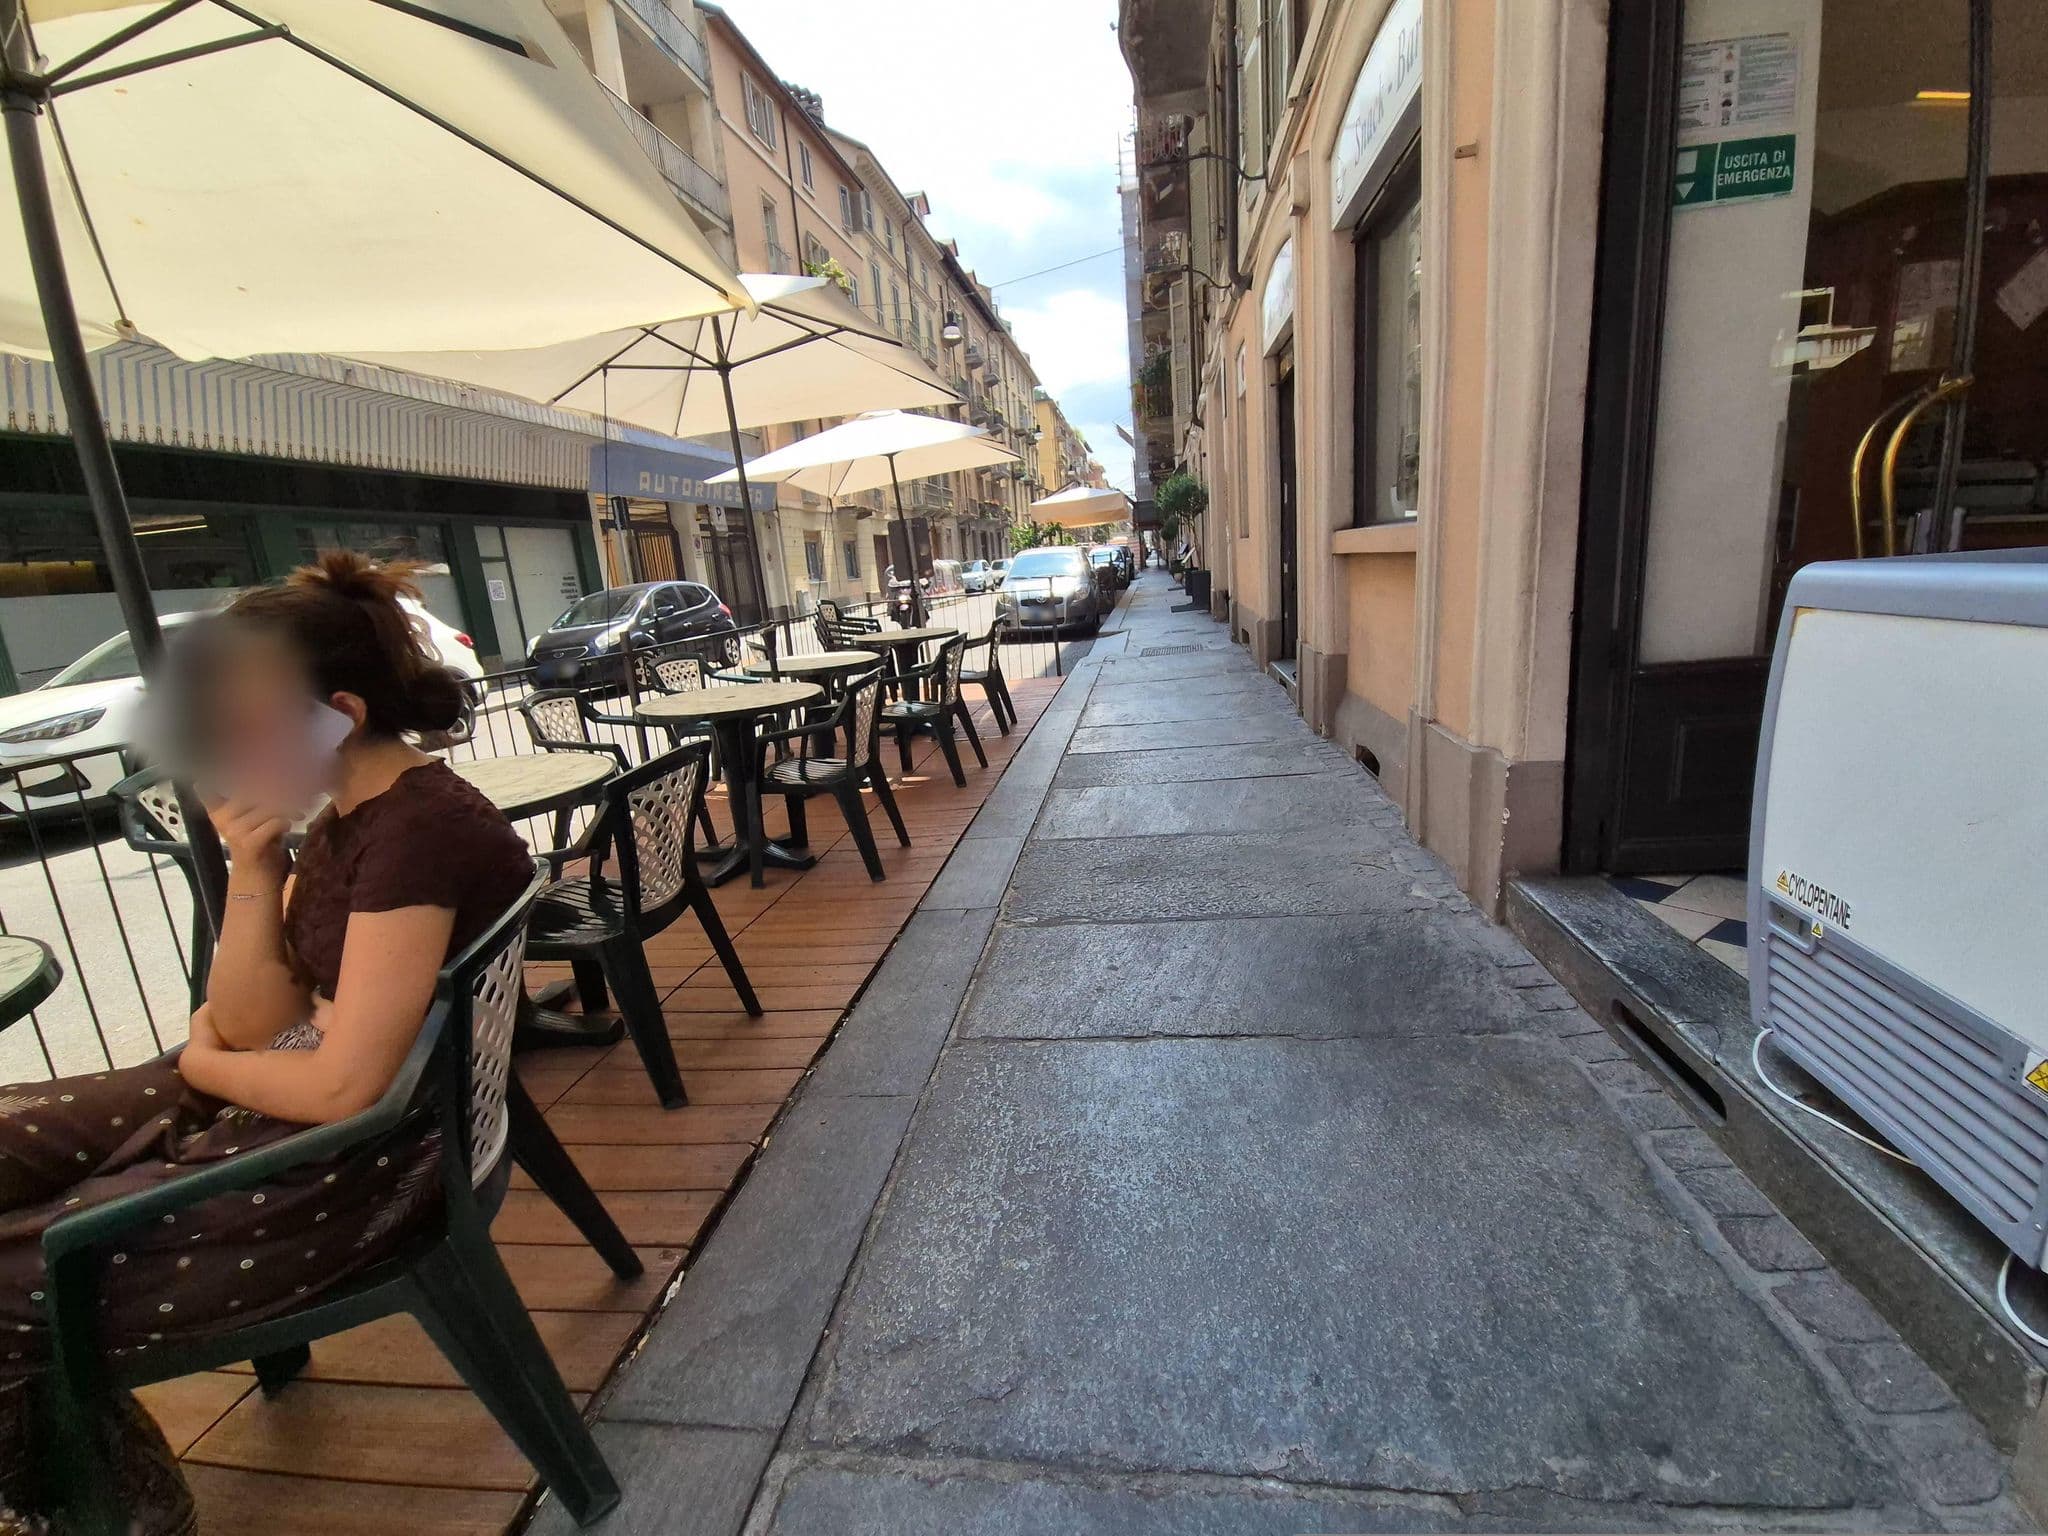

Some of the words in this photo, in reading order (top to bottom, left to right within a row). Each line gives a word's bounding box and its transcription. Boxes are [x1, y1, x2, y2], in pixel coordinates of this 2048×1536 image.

[1354, 74, 1385, 168] Snack
[1396, 15, 1423, 93] Bar
[1717, 165, 1791, 186] EMERGENZA
[1724, 151, 1768, 169] USCITA
[1773, 150, 1786, 163] DI
[1788, 873, 1851, 930] CYCLOPENTANE
